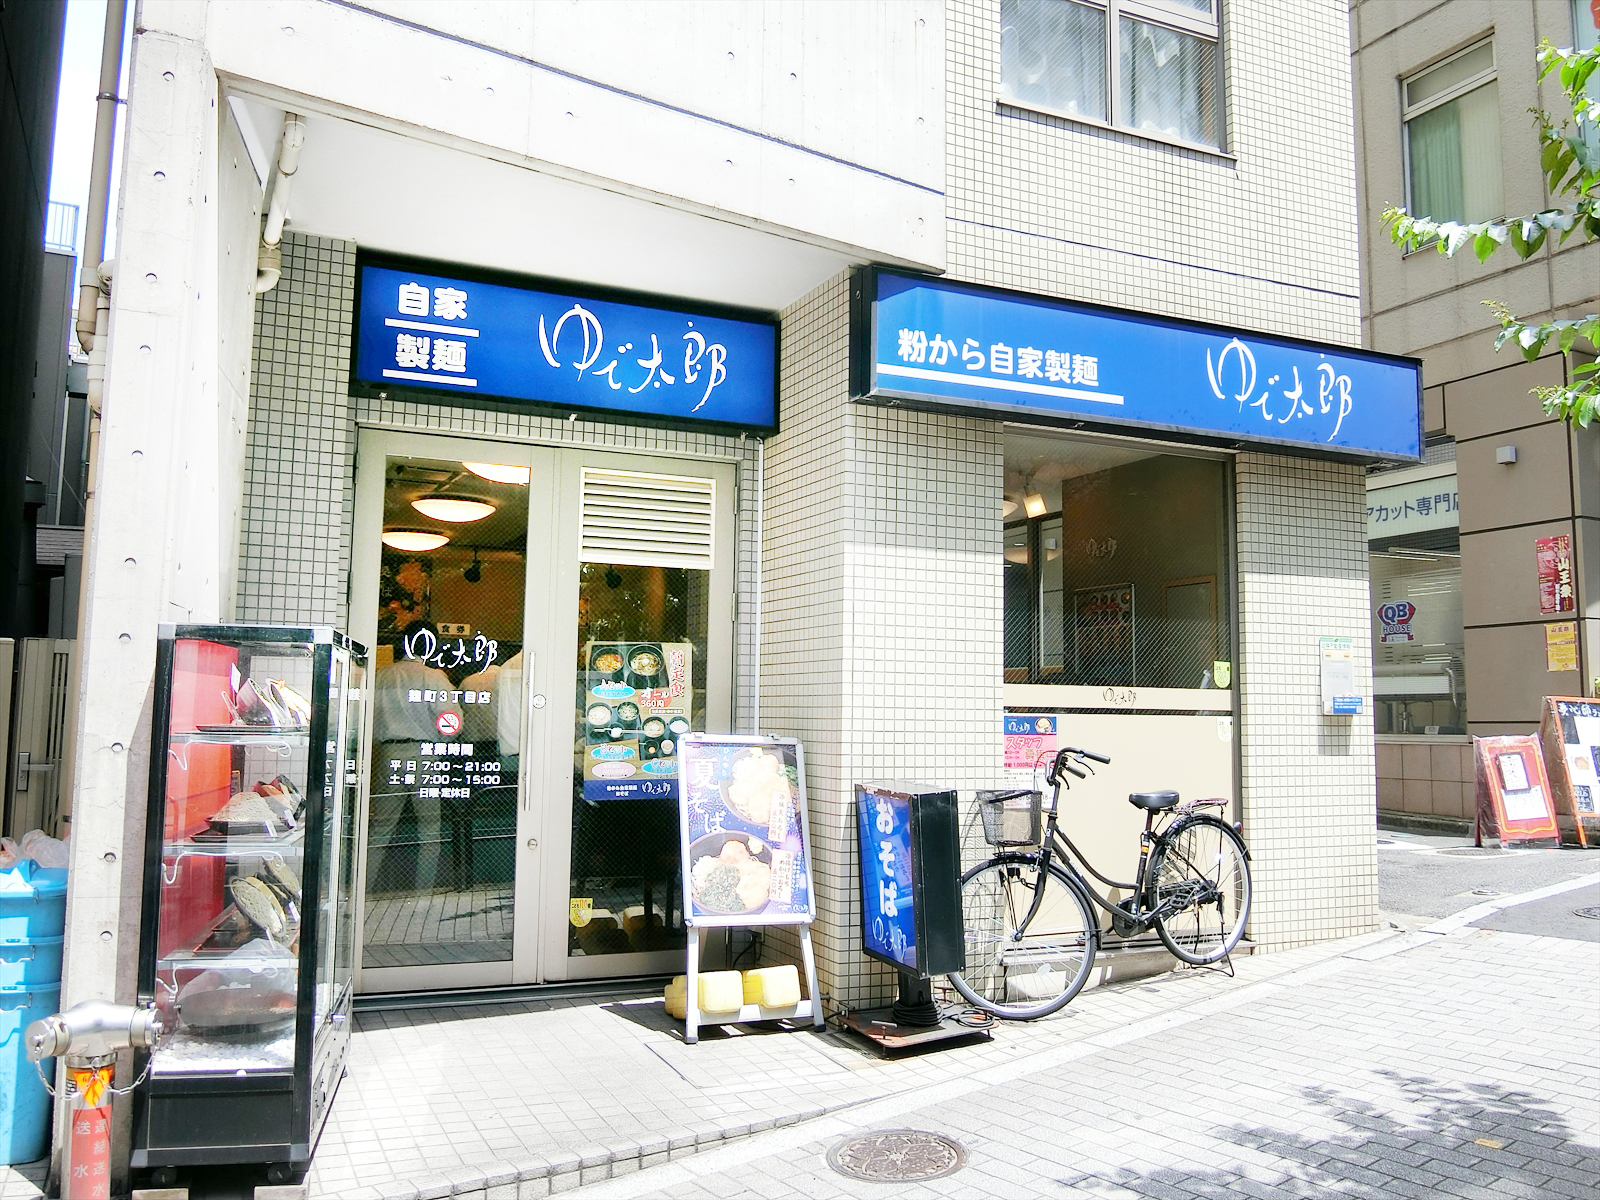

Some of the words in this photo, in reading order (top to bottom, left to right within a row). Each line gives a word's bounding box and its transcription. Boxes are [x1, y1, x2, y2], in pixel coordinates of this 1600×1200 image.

[398, 282, 468, 320] 自家
[396, 333, 467, 373] 製麺
[538, 303, 727, 412] ゆで太郎
[897, 328, 1099, 387] 粉から自家製麺
[1207, 336, 1353, 442] ゆで太郎
[1383, 625, 1411, 634] HOUSE
[1384, 604, 1408, 622] QB
[404, 628, 498, 675] ゆで太郎
[1102, 687, 1137, 706] ゆで太郎
[420, 742, 474, 756] 営業時間
[722, 747, 730, 776] ひんやり
[1006, 736, 1043, 750] スタッフ
[688, 758, 727, 834] 夏そば
[876, 798, 898, 918] おそば
[872, 916, 908, 960] ゆで太郎
[74, 1120, 91, 1178] 送水
[92, 1118, 106, 1197] 連結送水
